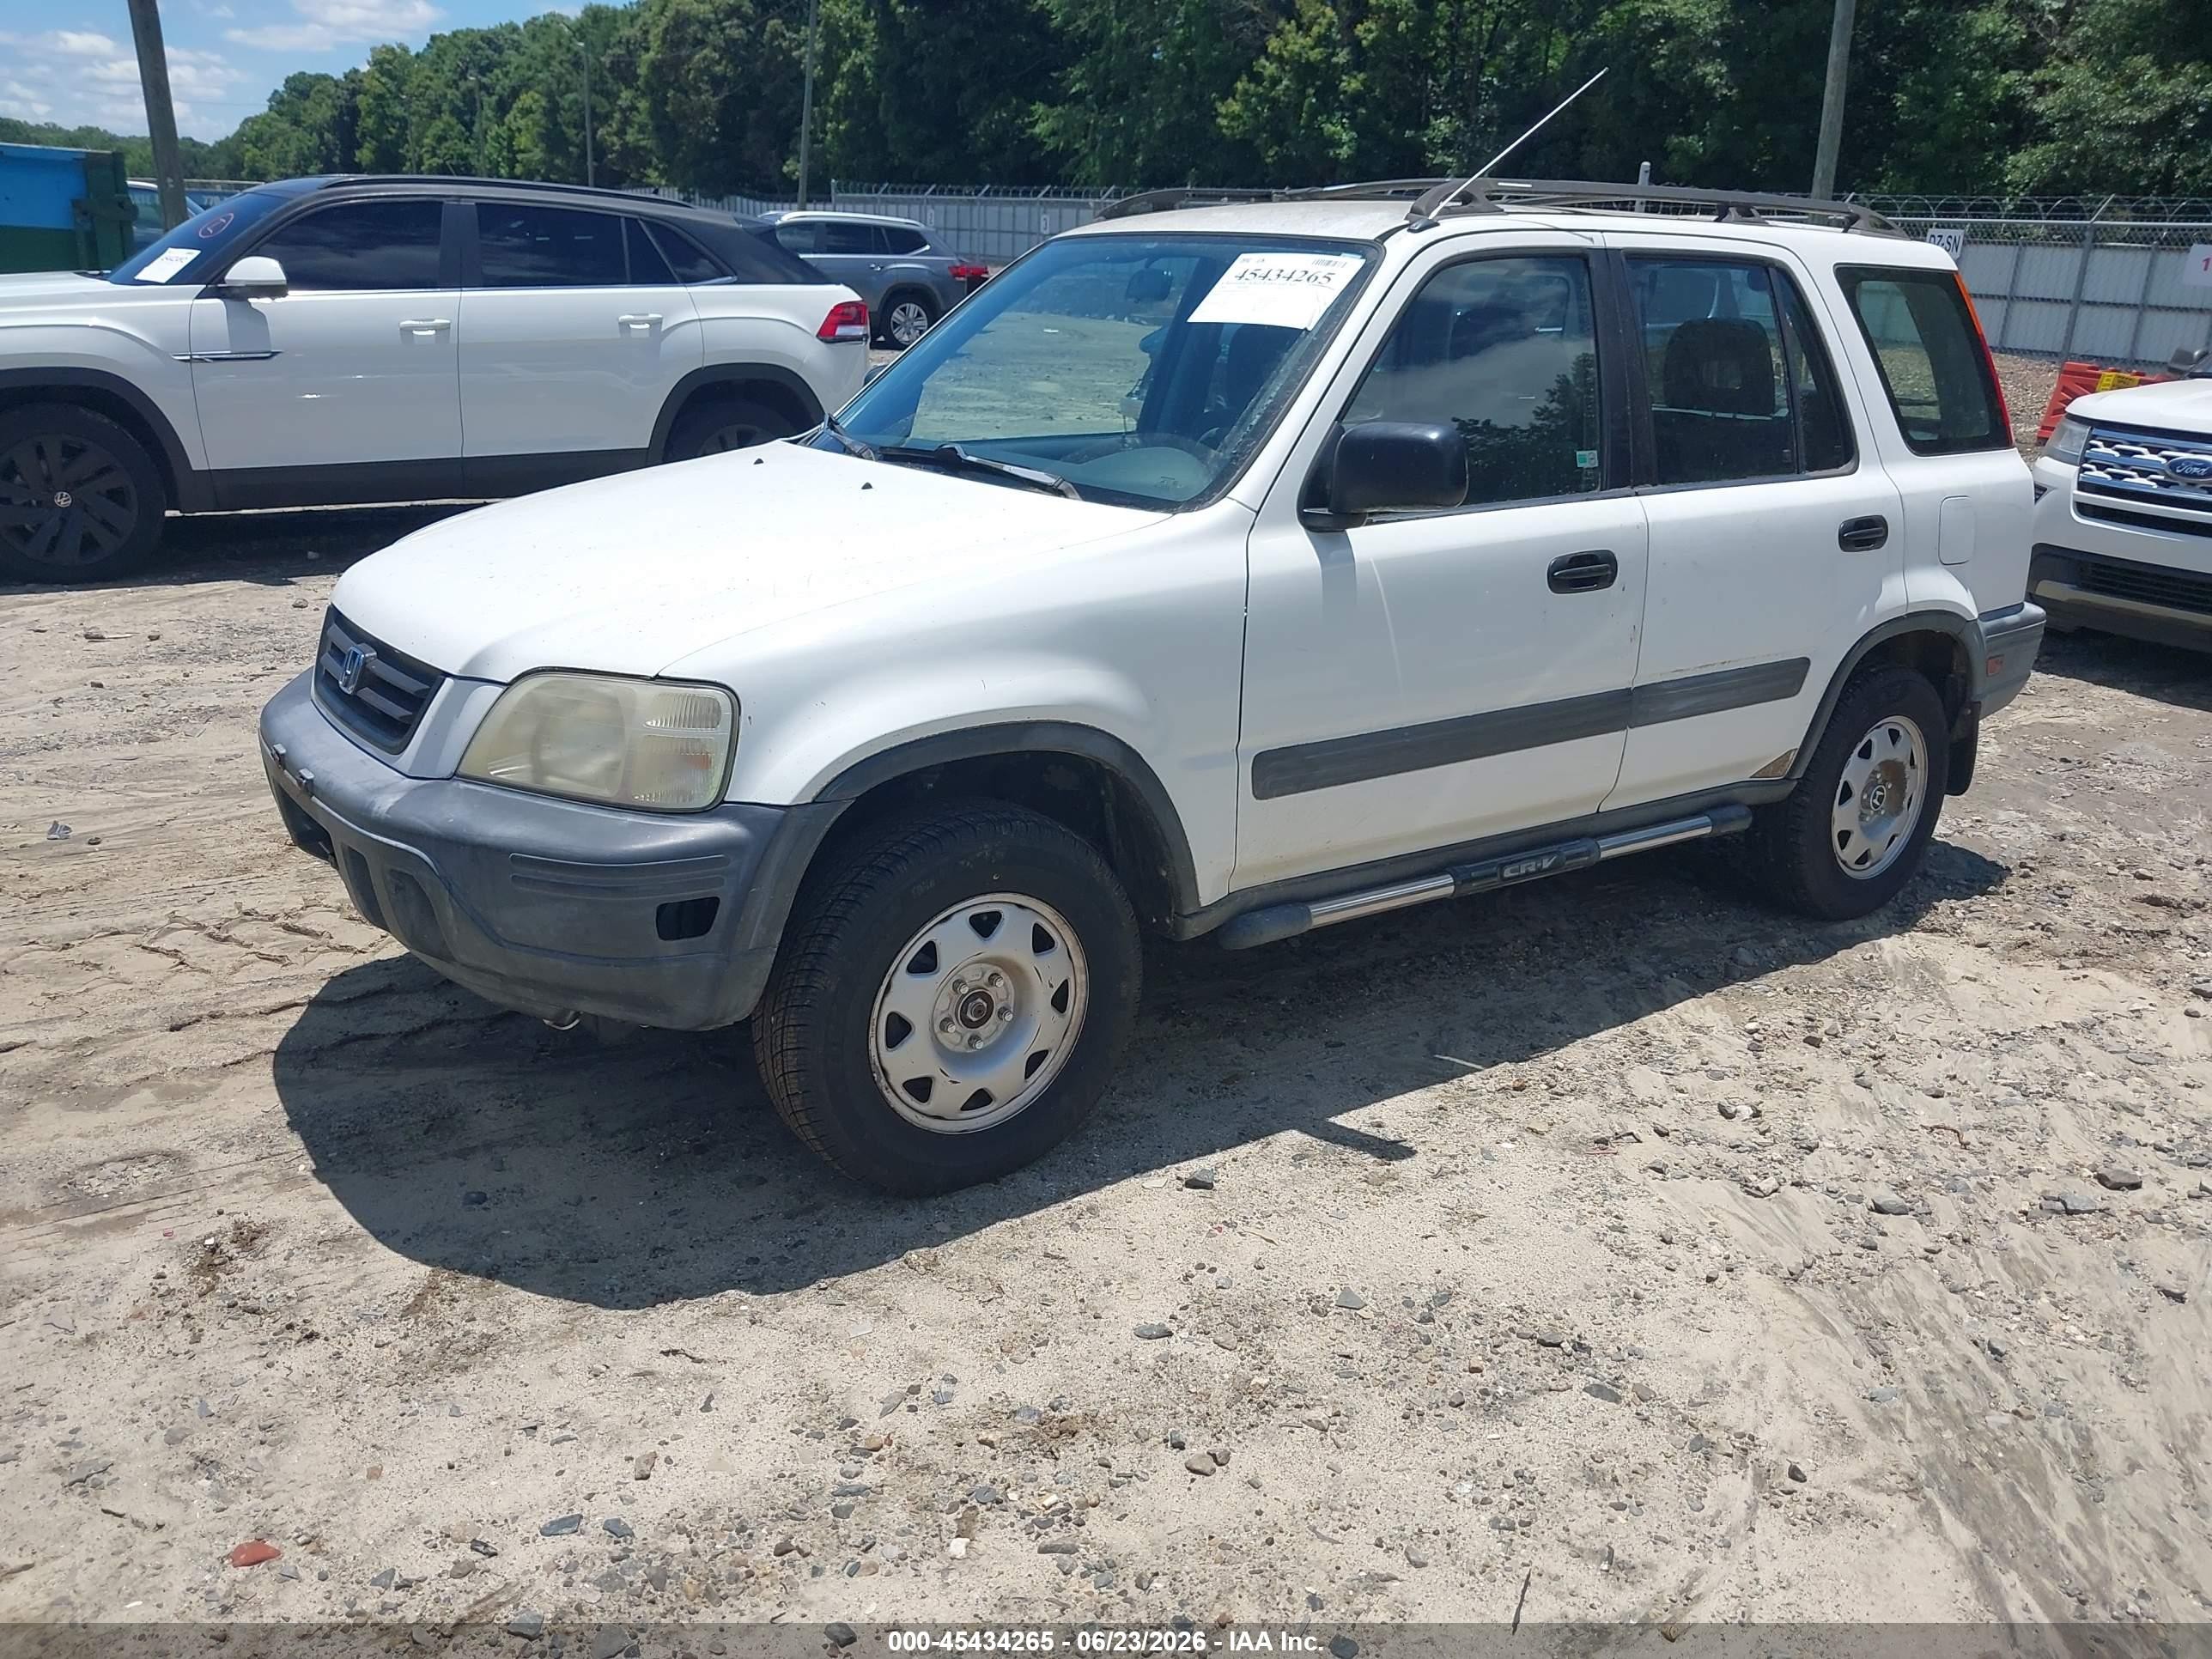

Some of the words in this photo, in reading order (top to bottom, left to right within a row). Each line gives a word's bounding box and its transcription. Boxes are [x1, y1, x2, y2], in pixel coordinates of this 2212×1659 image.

[1234, 268, 1336, 285] 45434265
[2176, 463, 2209, 476] Ford
[1503, 854, 1558, 878] CR-V
